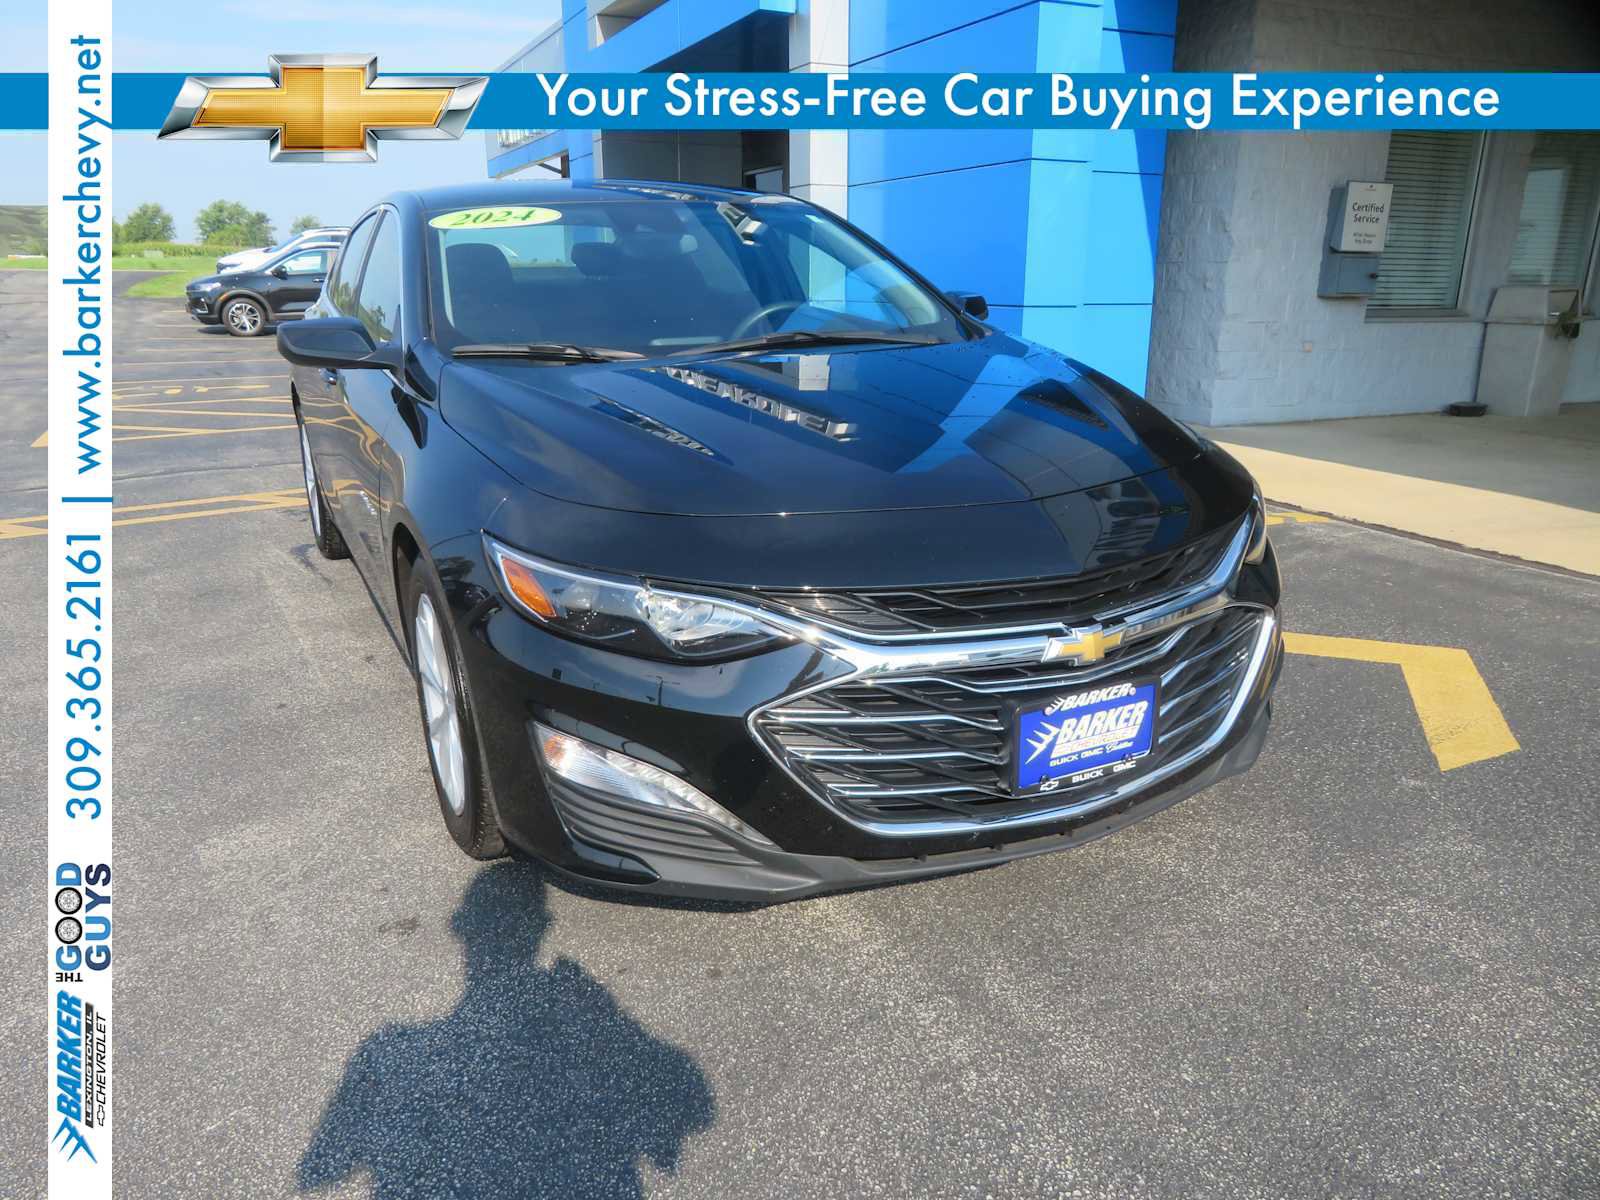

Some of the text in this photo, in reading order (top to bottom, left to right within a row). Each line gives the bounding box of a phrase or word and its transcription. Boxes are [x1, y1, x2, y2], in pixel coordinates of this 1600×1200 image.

[1352, 202, 1384, 213] Certified
[451, 209, 536, 226] 2024
[1353, 213, 1380, 224] Service
[1061, 683, 1133, 711] BARKER
[1059, 701, 1148, 743] BARKER
[1050, 748, 1104, 767] BUICK GMC
[1072, 760, 1137, 783] BUICK GMC
